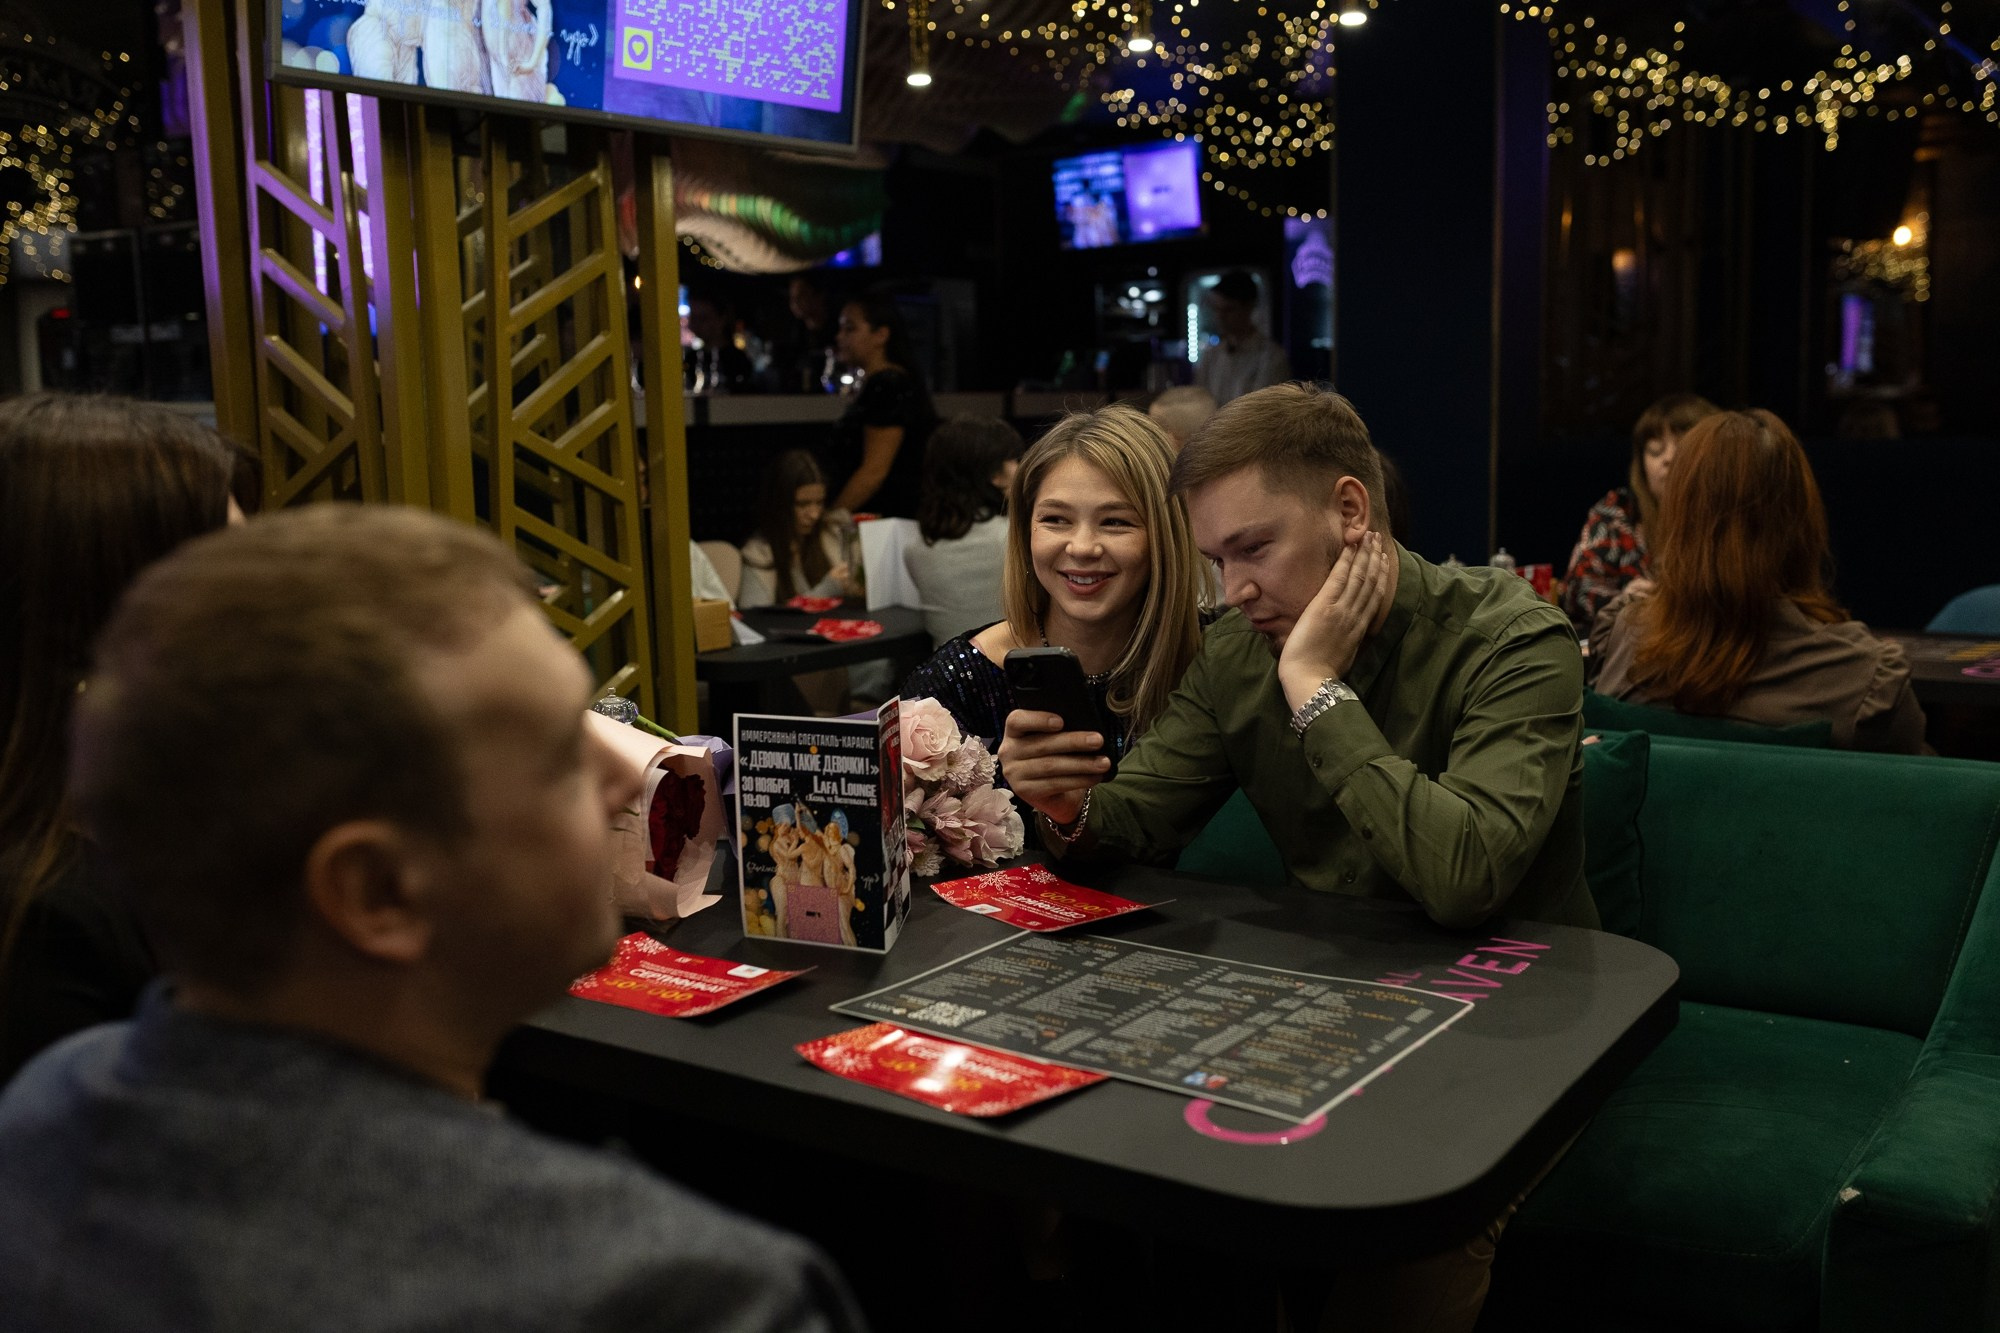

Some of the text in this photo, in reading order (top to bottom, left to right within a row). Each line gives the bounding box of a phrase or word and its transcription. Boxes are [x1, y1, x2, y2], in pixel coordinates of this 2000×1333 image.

[798, 733, 875, 750] СПЕКТАКЛЬ-КАРАОКЕ
[793, 753, 821, 772] ТАКИЕ
[741, 776, 790, 794] 30 НОЯБРЯ
